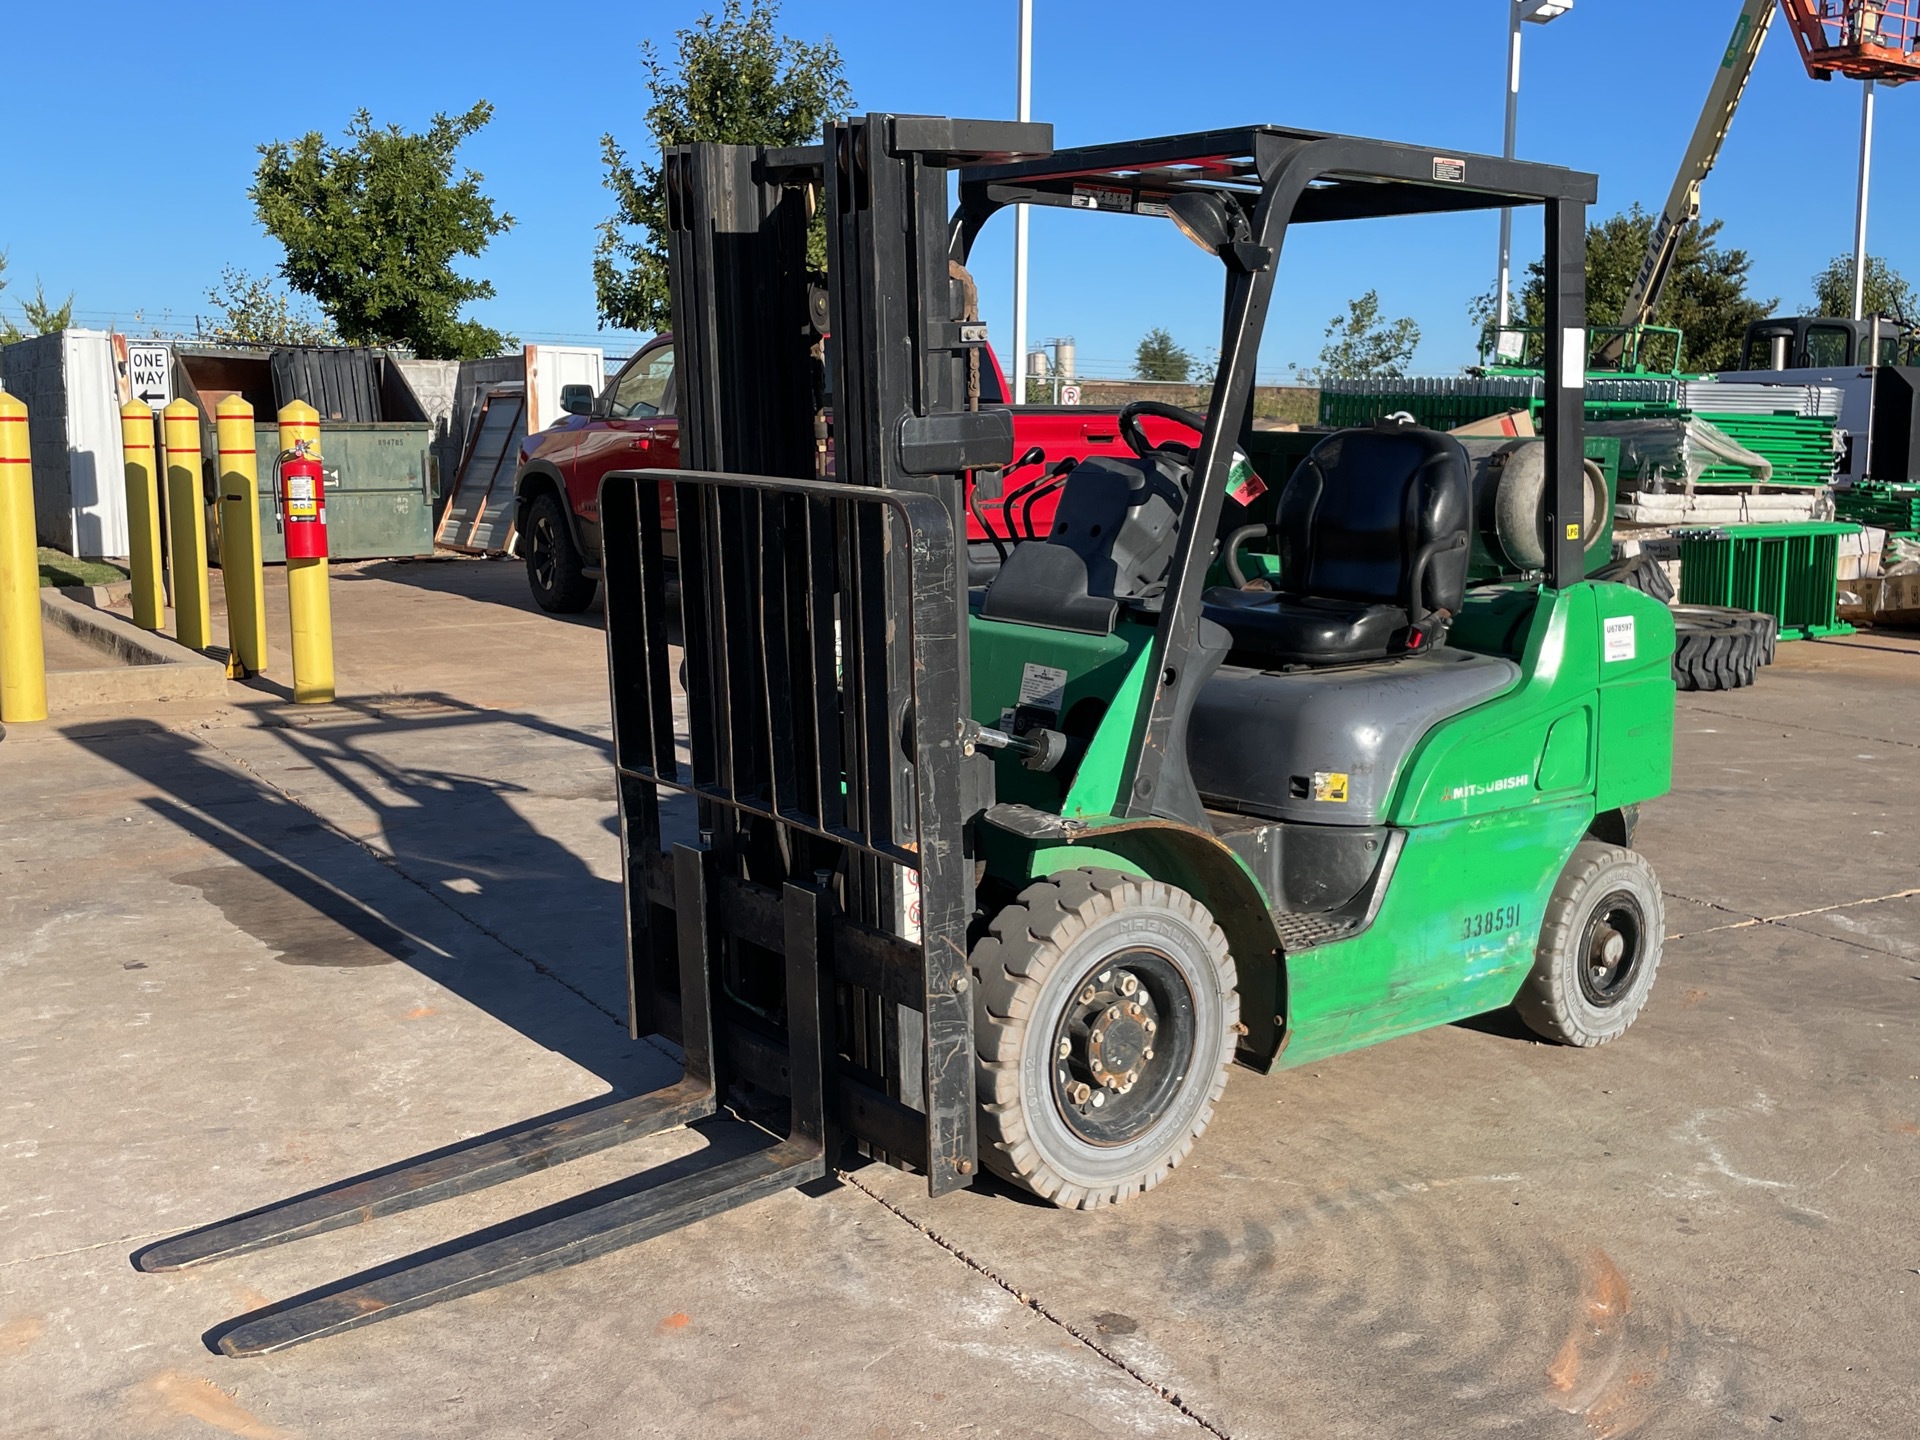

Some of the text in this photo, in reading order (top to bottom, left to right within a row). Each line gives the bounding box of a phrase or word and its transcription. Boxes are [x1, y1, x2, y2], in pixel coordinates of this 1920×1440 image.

[1638, 211, 1671, 293] JLG LIFT
[133, 354, 164, 367] ONE
[134, 371, 165, 385] WAY
[1567, 527, 1578, 537] LPG
[1452, 774, 1529, 799] MITSUBISHI
[1462, 903, 1520, 940] 338591
[1120, 918, 1193, 953] MAGNUM
